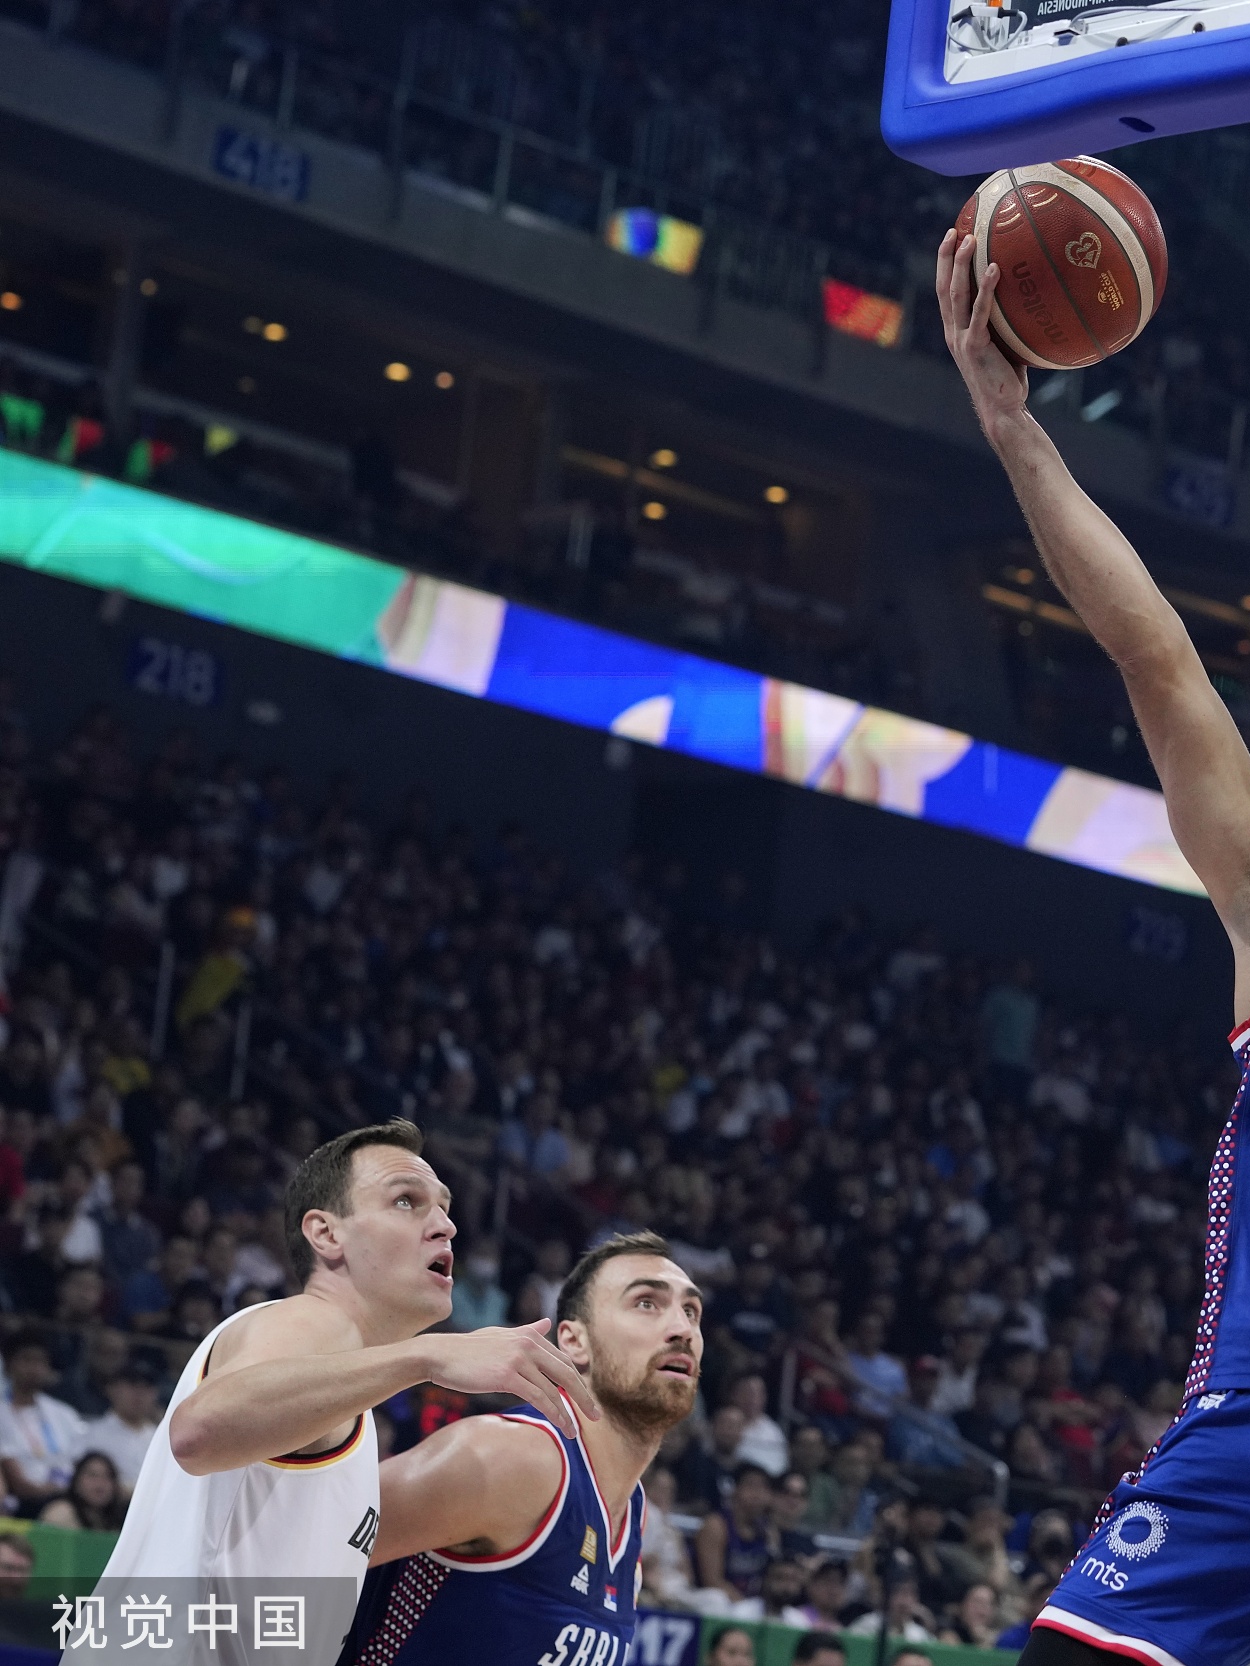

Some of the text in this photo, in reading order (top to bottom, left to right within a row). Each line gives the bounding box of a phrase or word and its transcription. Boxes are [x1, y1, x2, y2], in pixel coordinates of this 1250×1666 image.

[1011, 260, 1070, 346] molten
[136, 638, 216, 706] 218
[1080, 1556, 1129, 1592] mts
